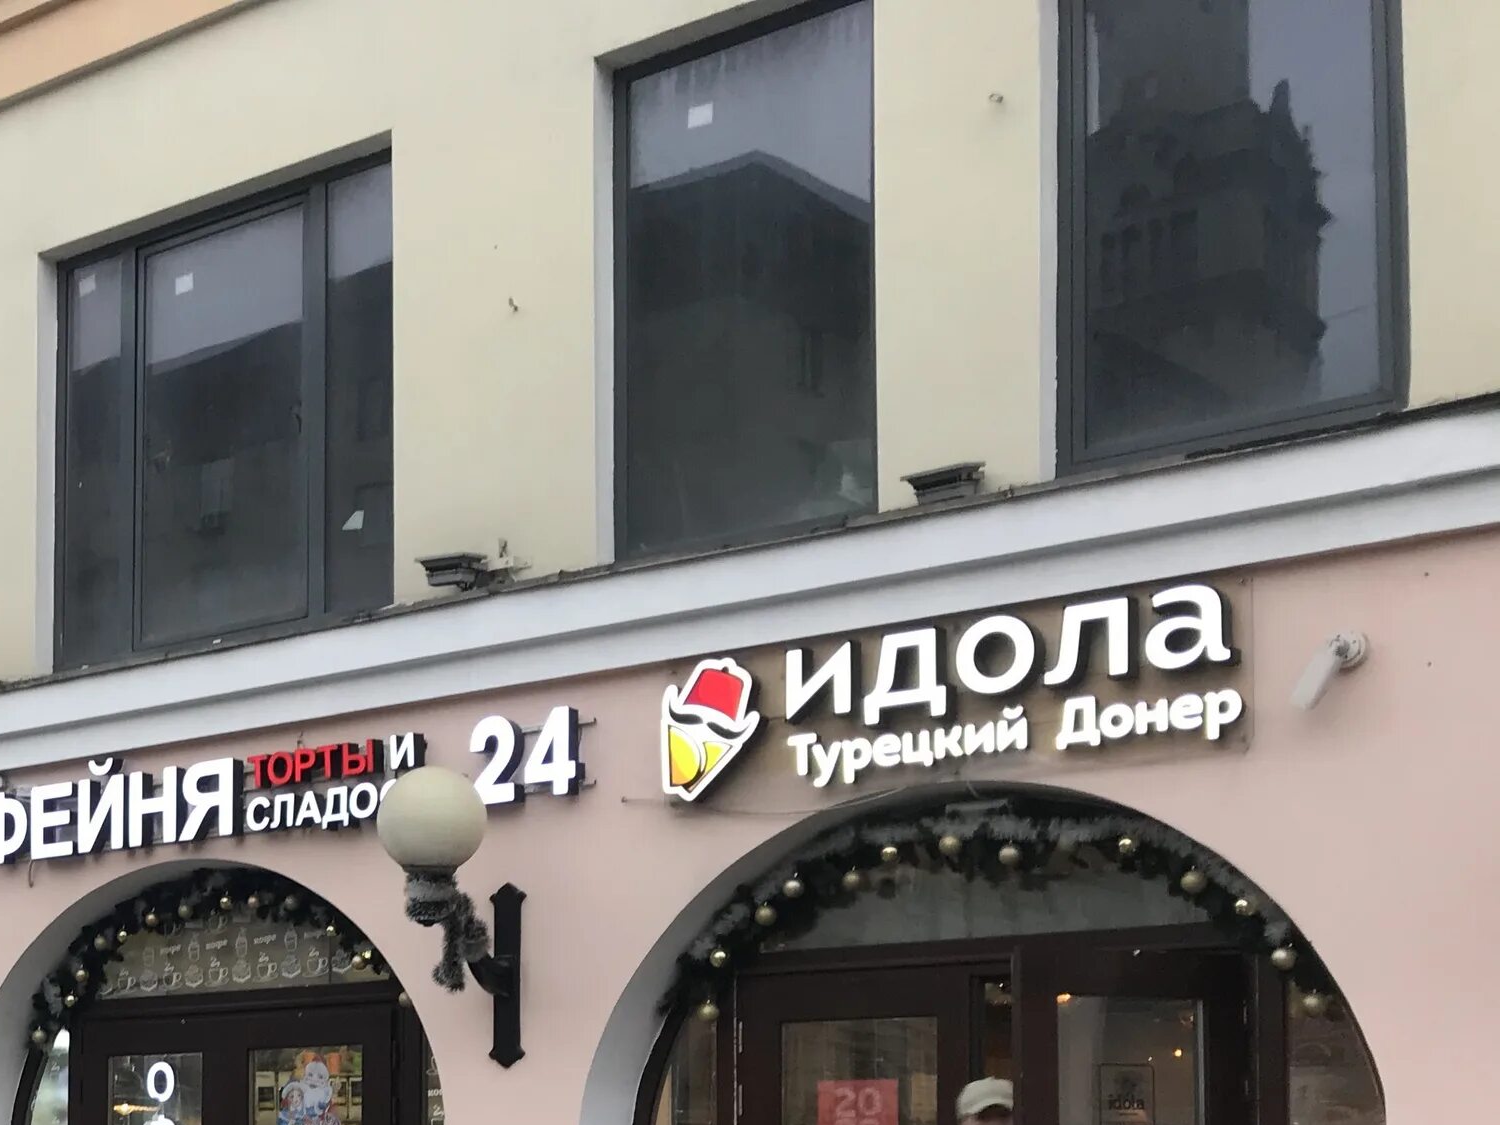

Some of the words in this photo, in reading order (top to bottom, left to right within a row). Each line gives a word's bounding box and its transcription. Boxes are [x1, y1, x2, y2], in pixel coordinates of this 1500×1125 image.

[785, 584, 1232, 725] идола
[247, 740, 373, 789] ТОРТЫ
[389, 732, 416, 770] И
[468, 704, 577, 806] 24
[786, 705, 1029, 788] Турецкий
[1055, 688, 1243, 751] Донер
[246, 778, 397, 832] СЛАДО
[835, 1086, 882, 1118] 20
